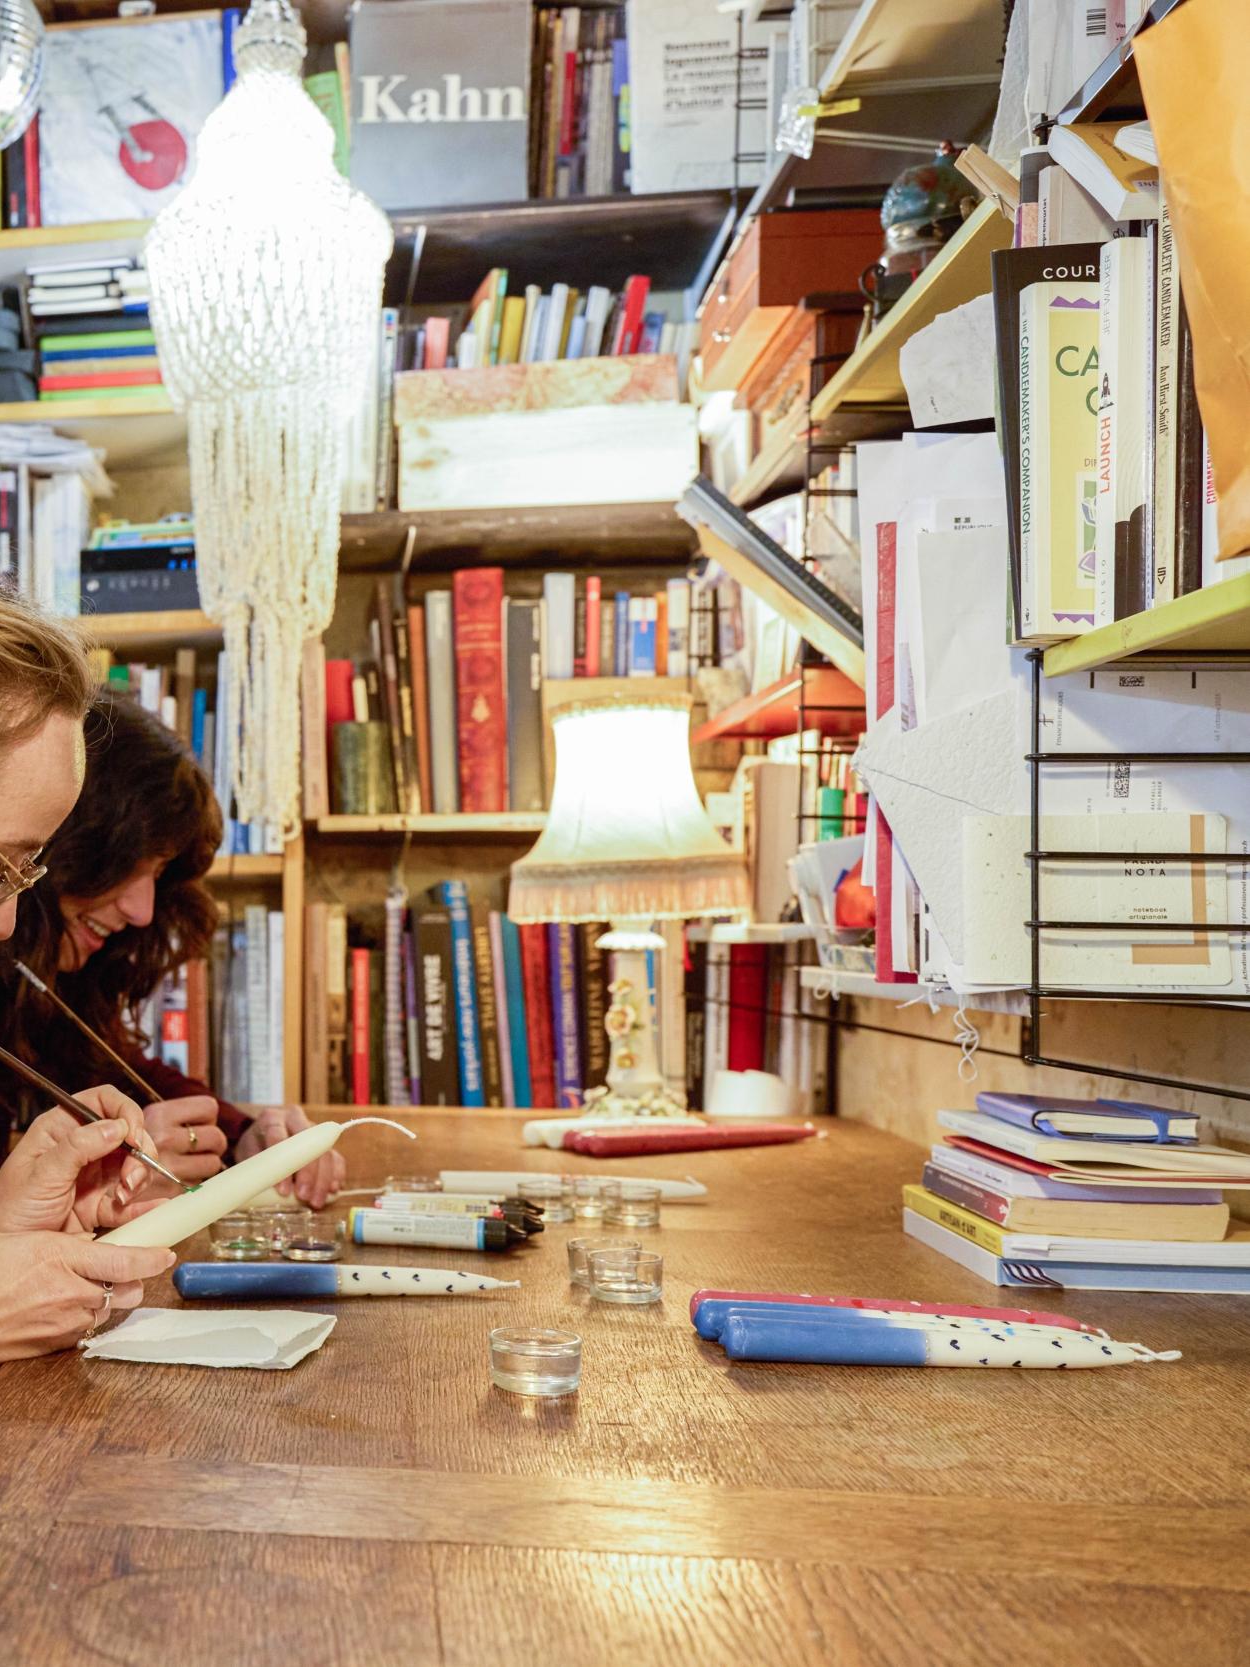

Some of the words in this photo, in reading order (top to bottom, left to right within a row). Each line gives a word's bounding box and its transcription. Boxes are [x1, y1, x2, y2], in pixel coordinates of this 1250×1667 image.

[357, 73, 527, 125] Kahn
[1042, 264, 1101, 280] COUR
[1161, 224, 1173, 275] COMPLETE
[1102, 254, 1112, 305] WALKER
[1102, 308, 1111, 334] JEFF
[1160, 277, 1172, 347] CANDLEMAKER
[1019, 336, 1030, 445] CANDLEMAKER'S
[1160, 365, 1168, 383] Ann
[1099, 416, 1111, 494] LAUNCH
[1021, 448, 1031, 534] COMPANION
[1124, 868, 1167, 877] NOTA
[1240, 881, 1248, 919] professionnel
[422, 954, 442, 1003] VIVRE
[424, 1004, 443, 1026] DE
[425, 1028, 444, 1061] ART
